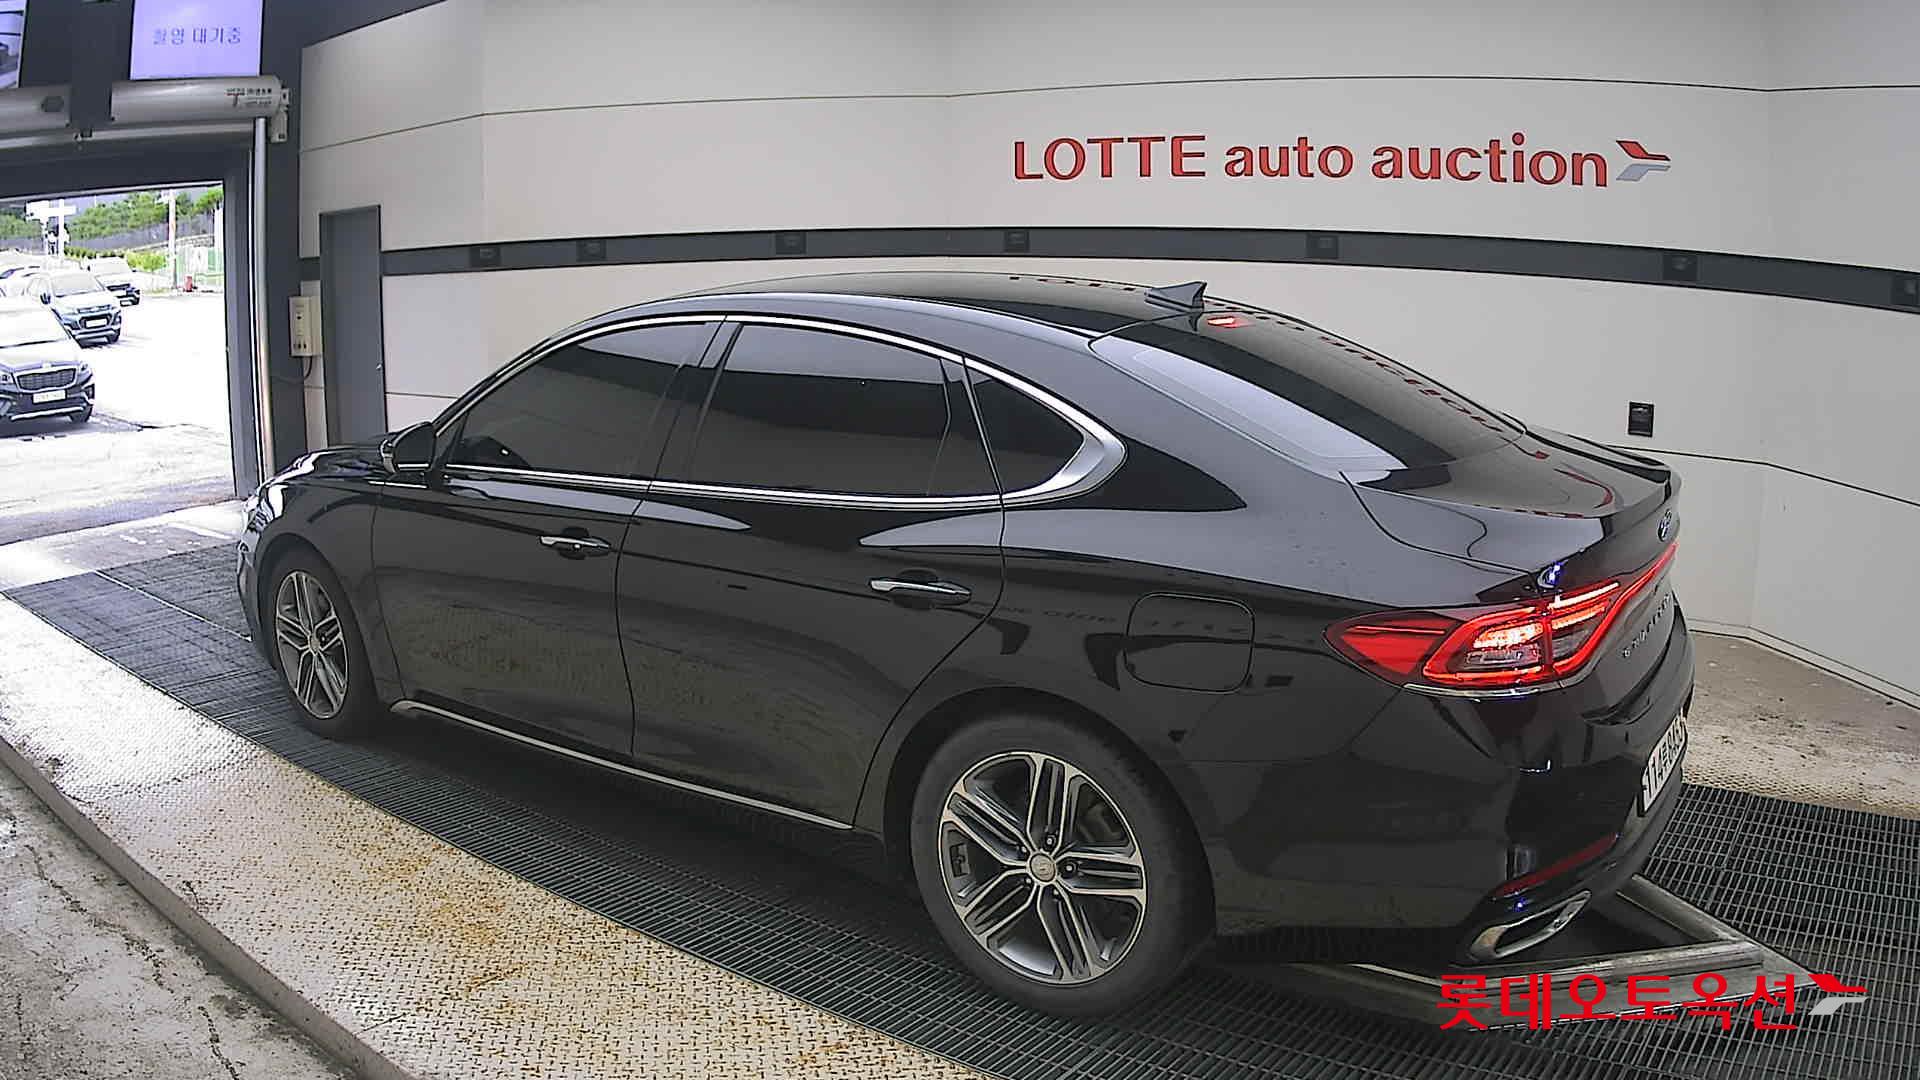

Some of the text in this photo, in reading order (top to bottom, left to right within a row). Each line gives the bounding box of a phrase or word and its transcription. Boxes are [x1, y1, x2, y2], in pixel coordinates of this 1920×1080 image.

[1013, 132, 1608, 188] LOTTE auto auction
